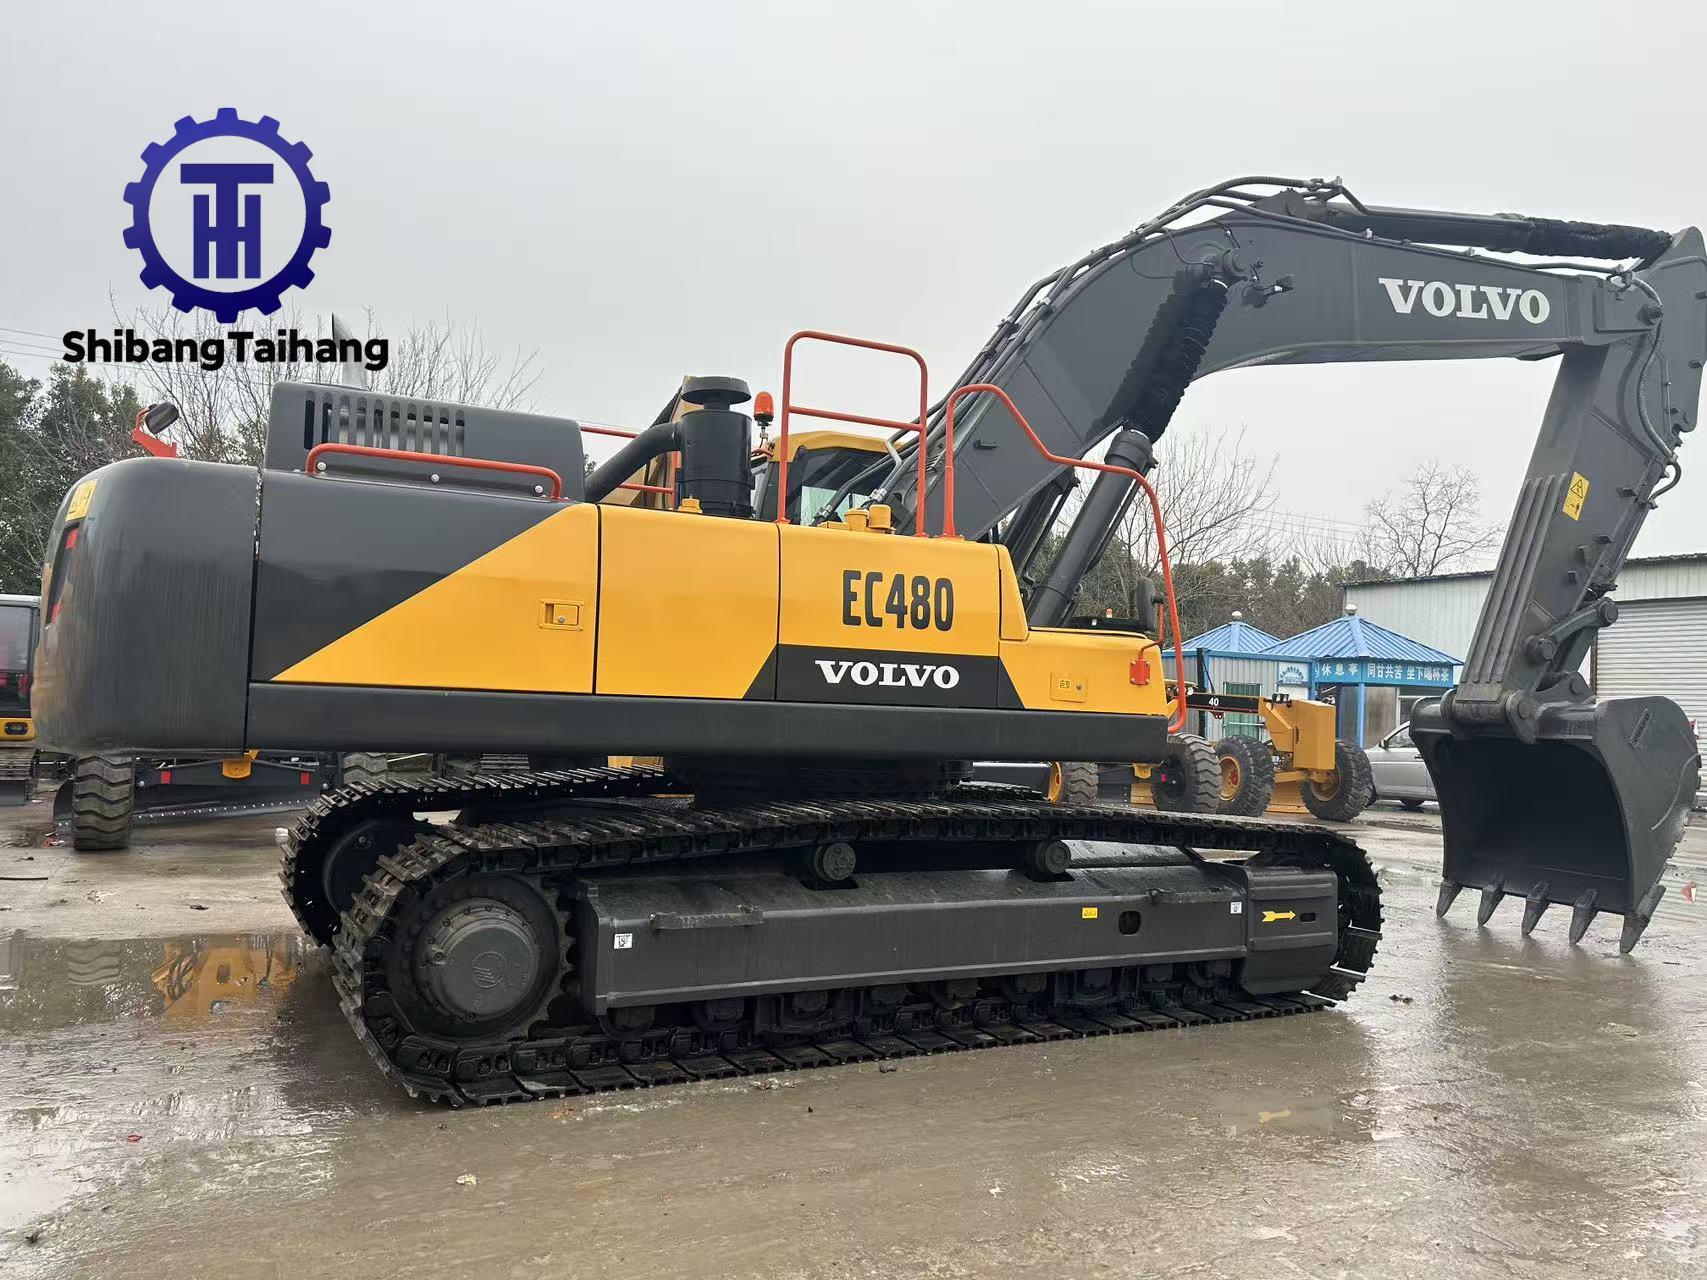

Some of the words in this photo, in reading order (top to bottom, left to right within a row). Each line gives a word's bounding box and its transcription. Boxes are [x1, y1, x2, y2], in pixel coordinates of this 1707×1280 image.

[1378, 277, 1550, 324] VOLVO
[843, 570, 954, 631] EC480
[815, 660, 959, 689] VOLVO
[1321, 663, 1359, 677] 休息亭
[1367, 663, 1403, 680] 同甘共苦
[1208, 697, 1219, 707] 40
